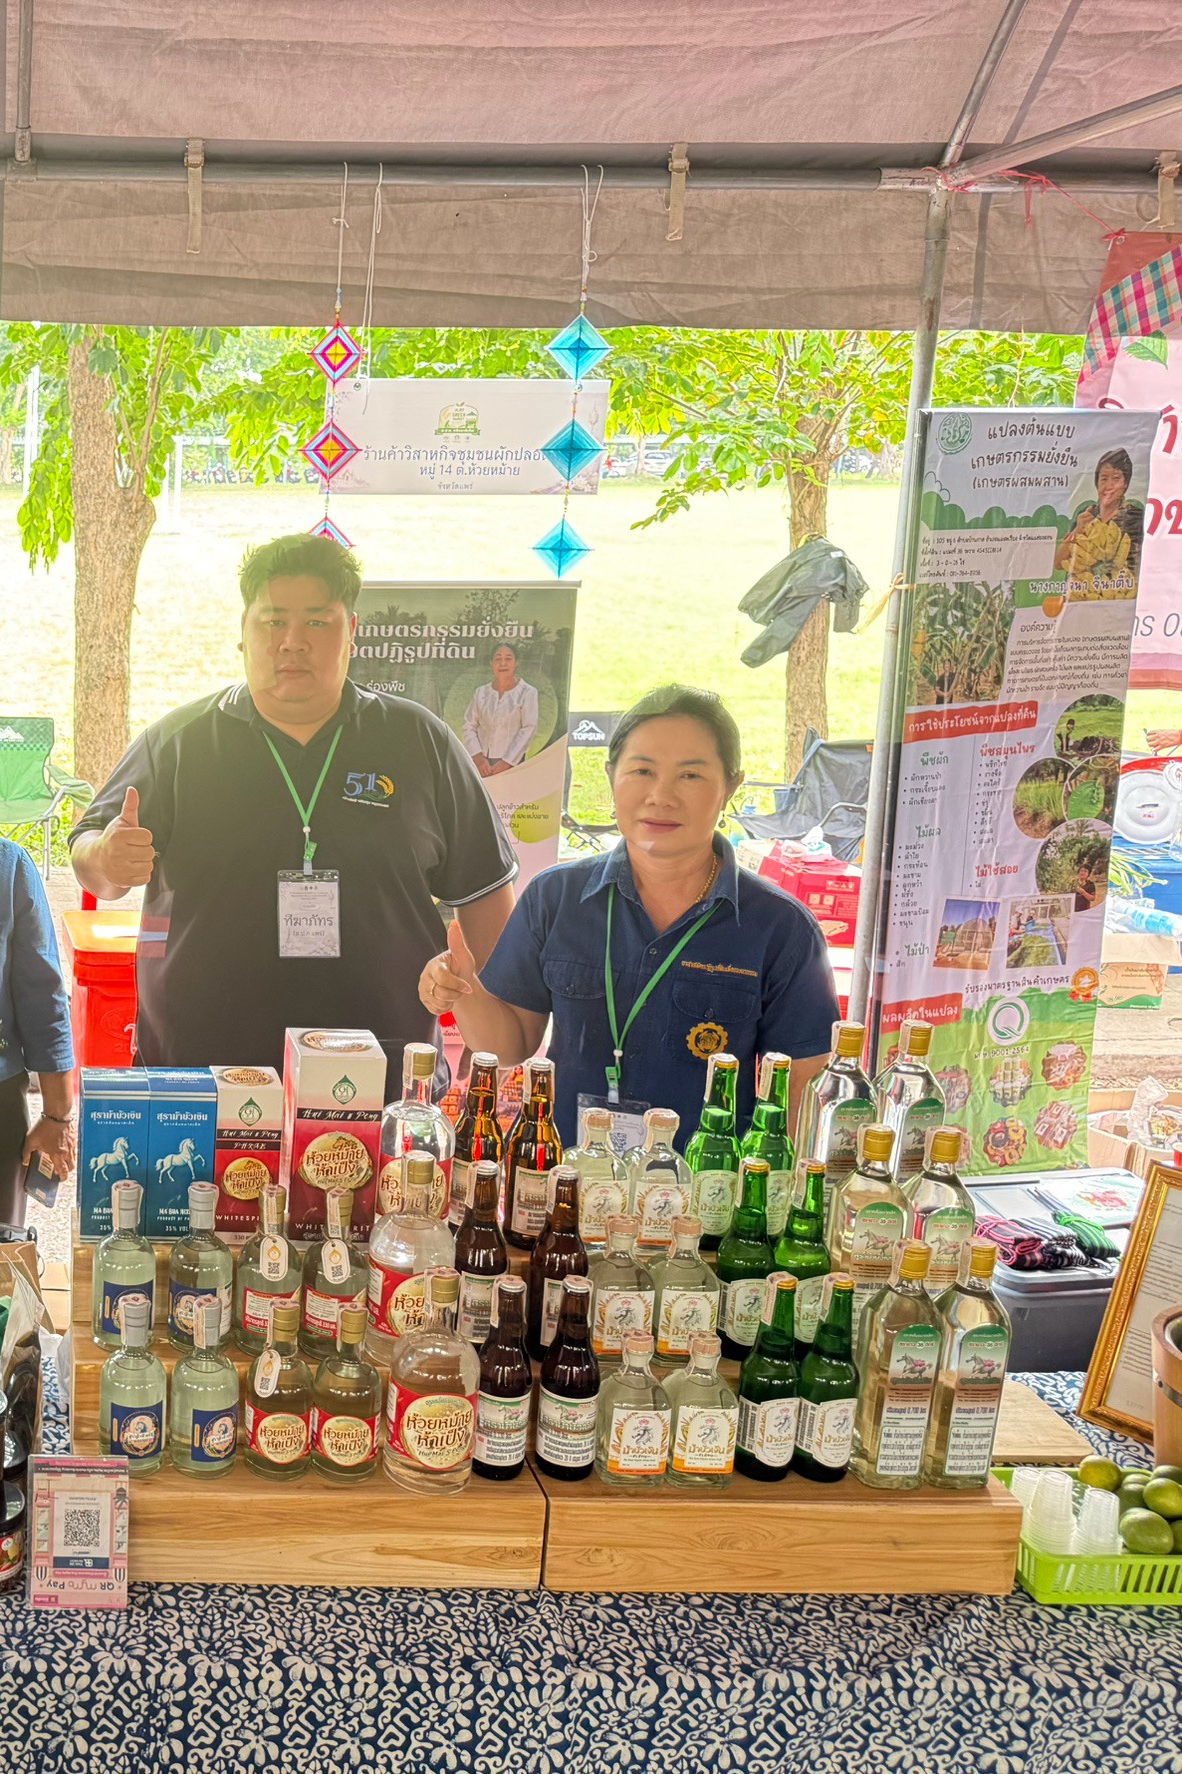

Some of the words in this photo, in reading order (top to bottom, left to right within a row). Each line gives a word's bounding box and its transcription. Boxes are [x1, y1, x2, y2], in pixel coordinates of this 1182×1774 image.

[987, 416, 1076, 440] แปลงต้นแบบ
[971, 440, 1079, 470] เกษตรกรรมยั่งยืน
[419, 463, 436, 479] หมู่
[439, 464, 453, 475] 14
[972, 474, 1069, 490] (เกษตรผสมผสาน)
[355, 617, 534, 638] เกษตรกรรมยั่งยืน
[908, 707, 1037, 733] การใช้ประโยชน์จากแปลงที่ดิน
[571, 732, 606, 741] TOPSUN
[980, 741, 1036, 760] พืชสมุนไพร
[920, 751, 949, 766] พืชผัก
[343, 772, 377, 796] 51
[915, 824, 941, 838] ไม้ผล
[905, 843, 924, 851] มะม่วง
[975, 863, 1018, 878] ไม้ใช้สอย
[900, 900, 917, 908] กล้วย
[904, 943, 930, 956] ไม้ป่า
[965, 974, 1070, 994] รับรองมาตรฐานสินค้าเกษตร
[882, 1005, 959, 1024] ผลผลิตในแปลง
[91, 1110, 141, 1121] สุราม้าบัวเงิน
[157, 1111, 208, 1122] สุราม้าบัวเงิน
[355, 1111, 378, 1122] Peng
[233, 1142, 267, 1150] PHRAE
[305, 1147, 364, 1165] ห้วยหม้าย
[406, 1408, 473, 1430] ห้วยหม้าย
[259, 1424, 305, 1437] ห้วยหม้าย
[323, 1427, 370, 1439] ห้วยหม้าย
[46, 1579, 65, 1591] Pay
[100, 1581, 115, 1591] QR
